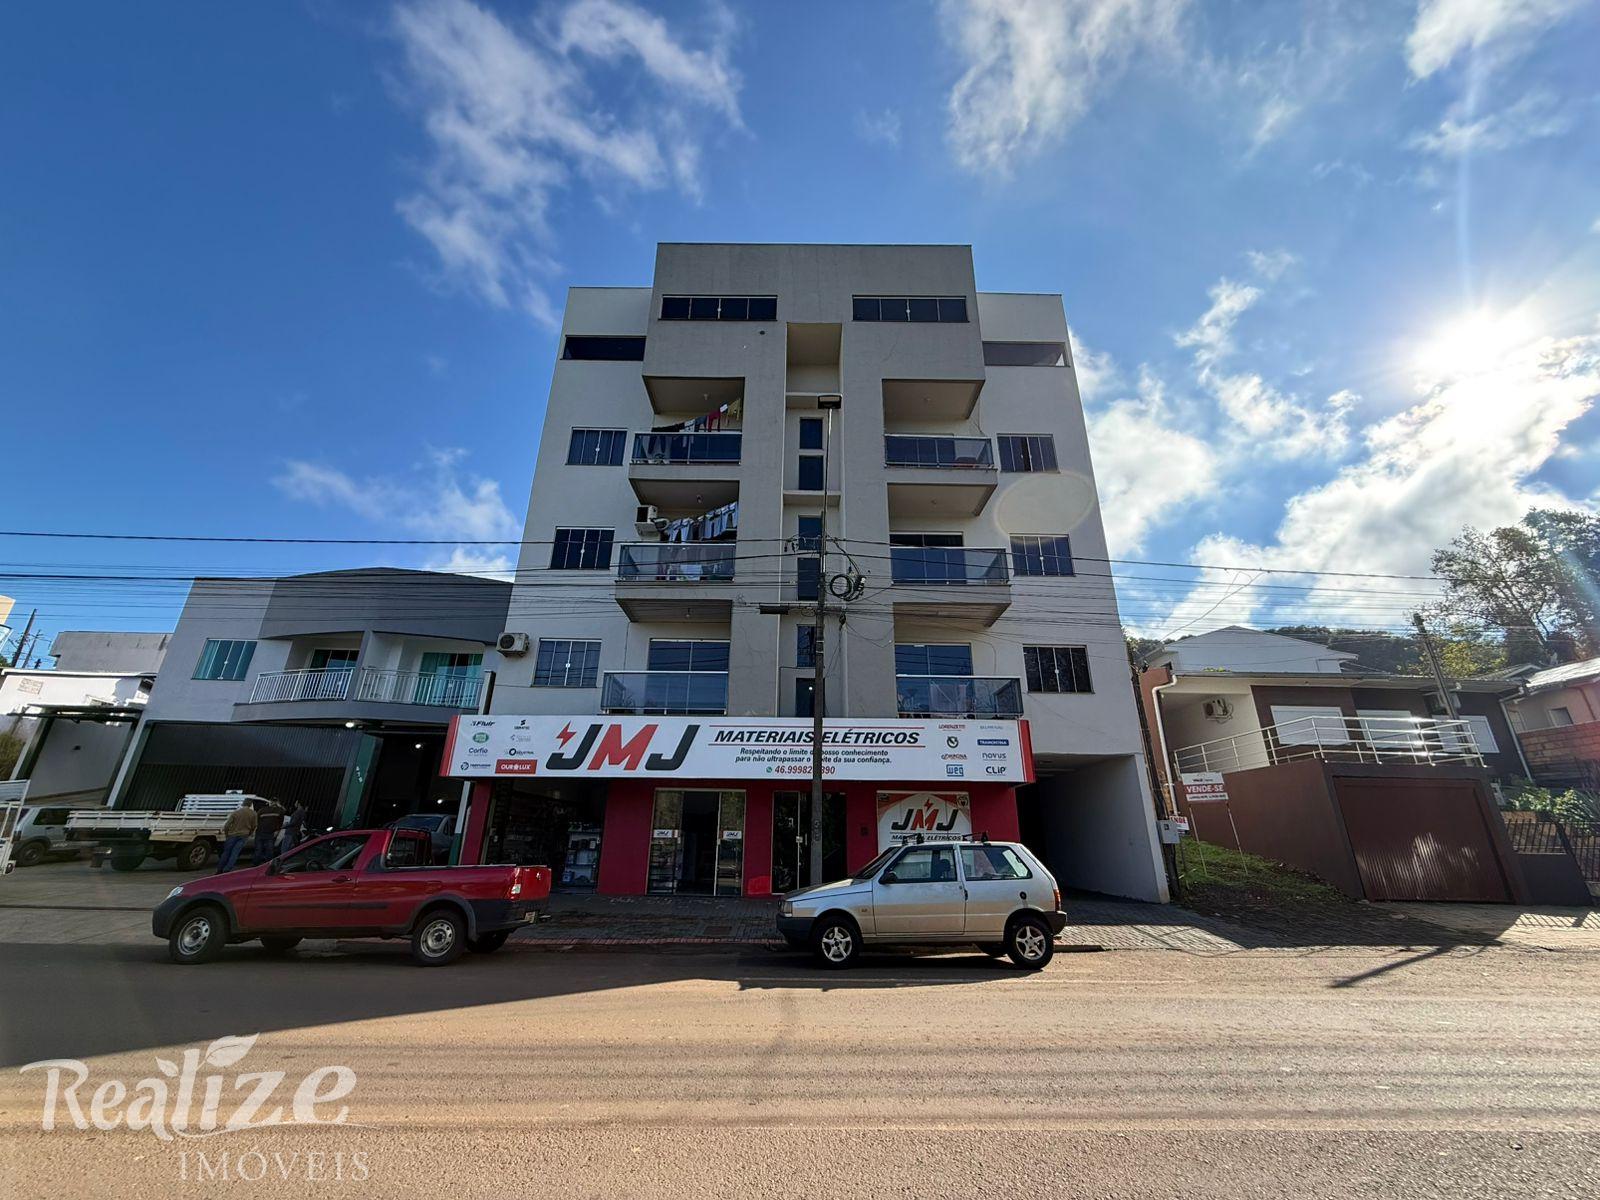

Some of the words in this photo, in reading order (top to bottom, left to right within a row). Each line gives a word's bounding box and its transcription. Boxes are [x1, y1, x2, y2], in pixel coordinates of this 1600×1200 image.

[714, 730, 815, 743] MATERIAIS
[821, 729, 920, 744] ELÉTRICOS
[545, 724, 701, 770] JMJ
[740, 747, 781, 756] Respeitando
[766, 755, 805, 763] ultrapassar
[856, 756, 892, 764] confiança.
[1186, 784, 1224, 793] VENDE-SE
[891, 808, 959, 831] JMJ
